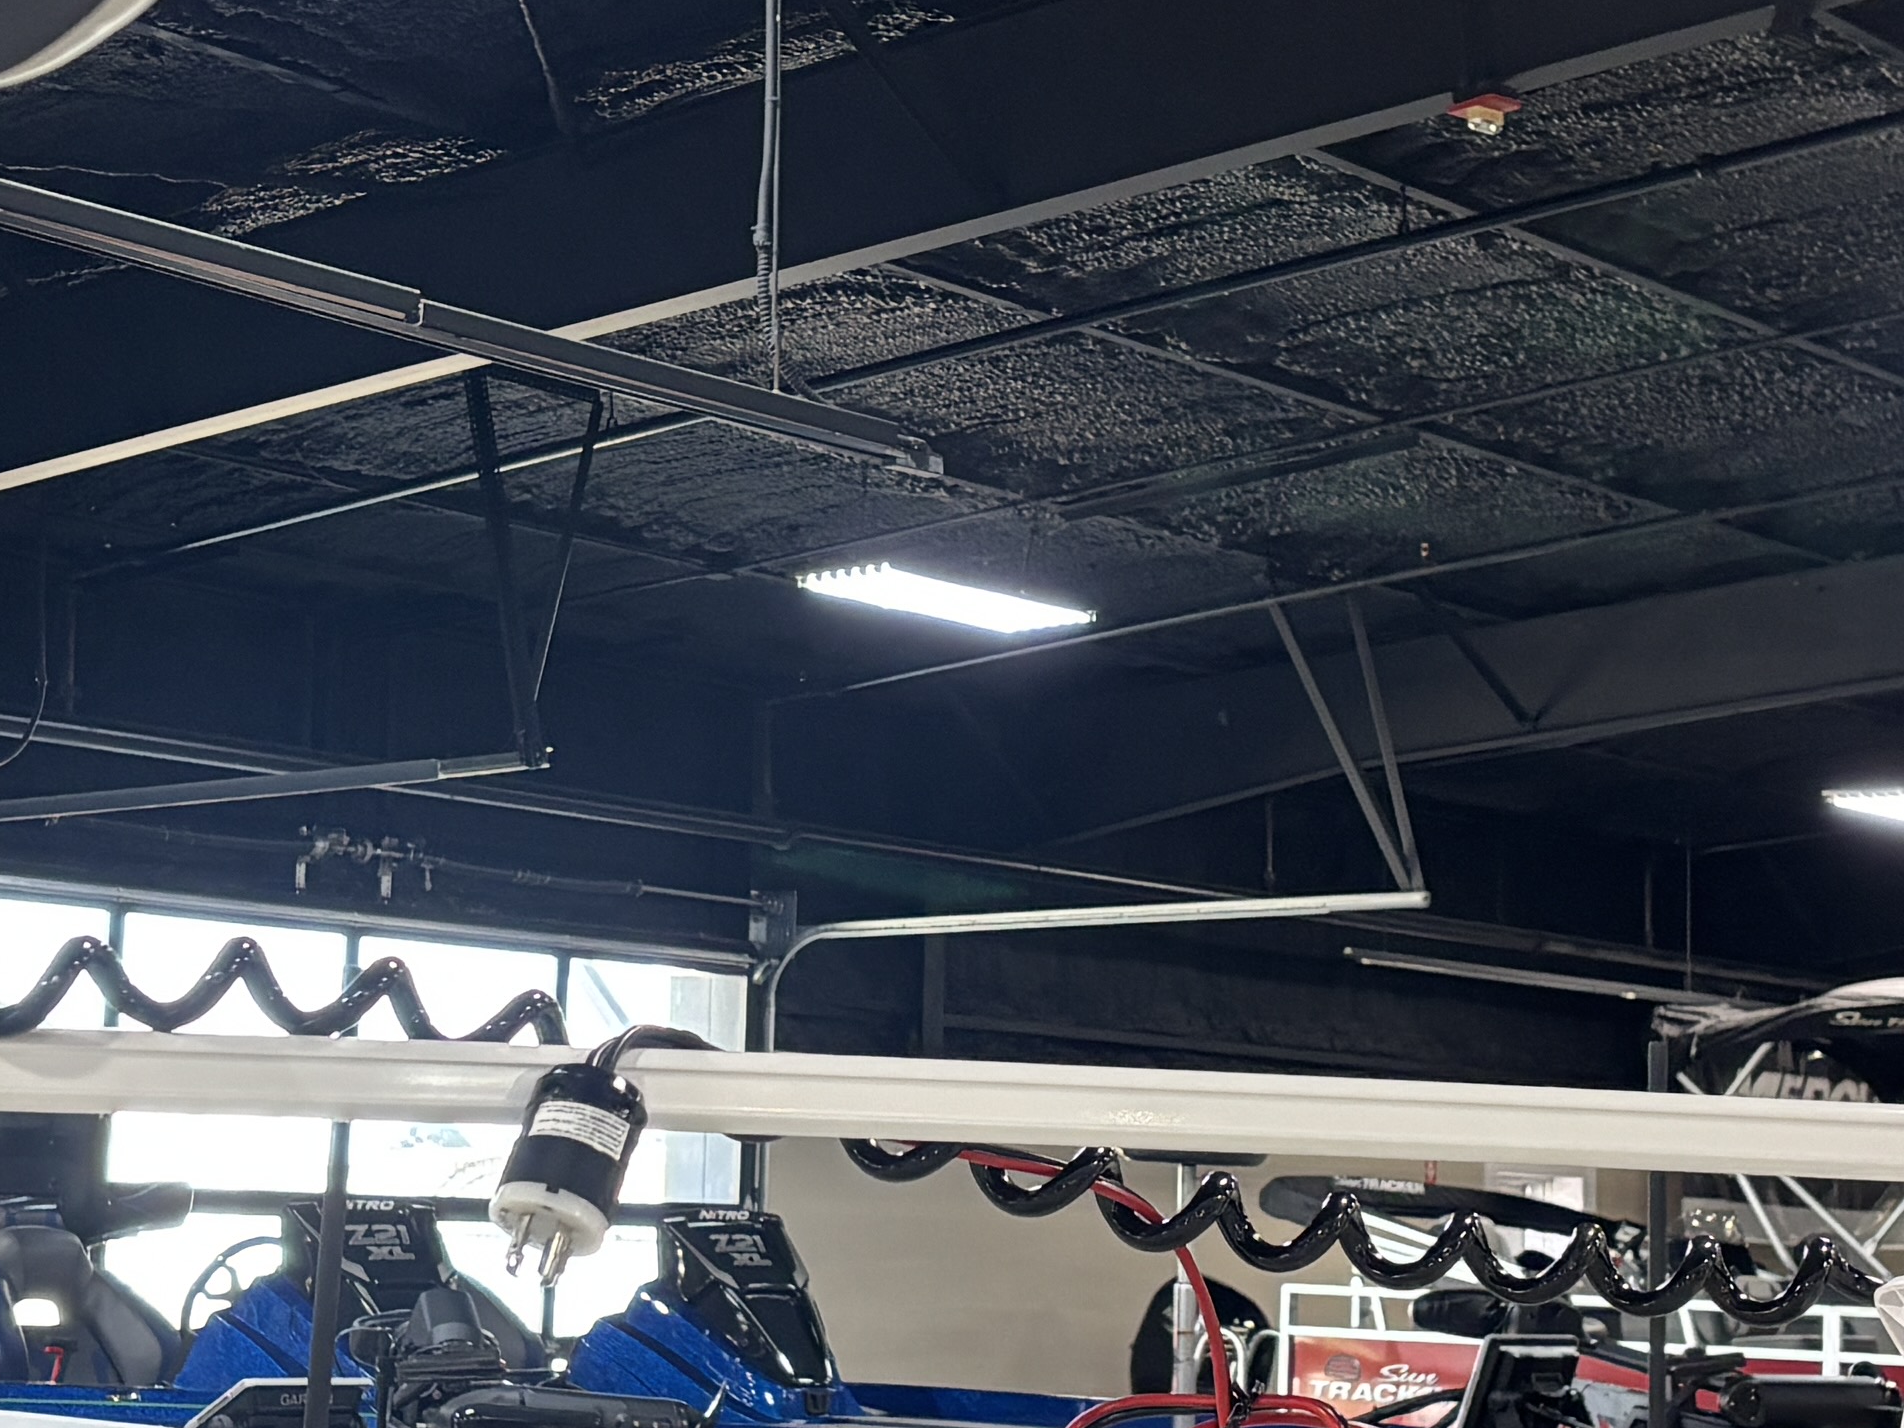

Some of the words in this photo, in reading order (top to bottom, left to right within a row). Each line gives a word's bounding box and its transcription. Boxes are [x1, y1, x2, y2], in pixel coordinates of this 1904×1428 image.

[698, 1209, 750, 1221] NITRO
[344, 1224, 411, 1246] Z21
[709, 1233, 767, 1254] Z21
[366, 1245, 416, 1261] XL
[728, 1253, 773, 1267] XL
[1379, 1363, 1439, 1385] Sun
